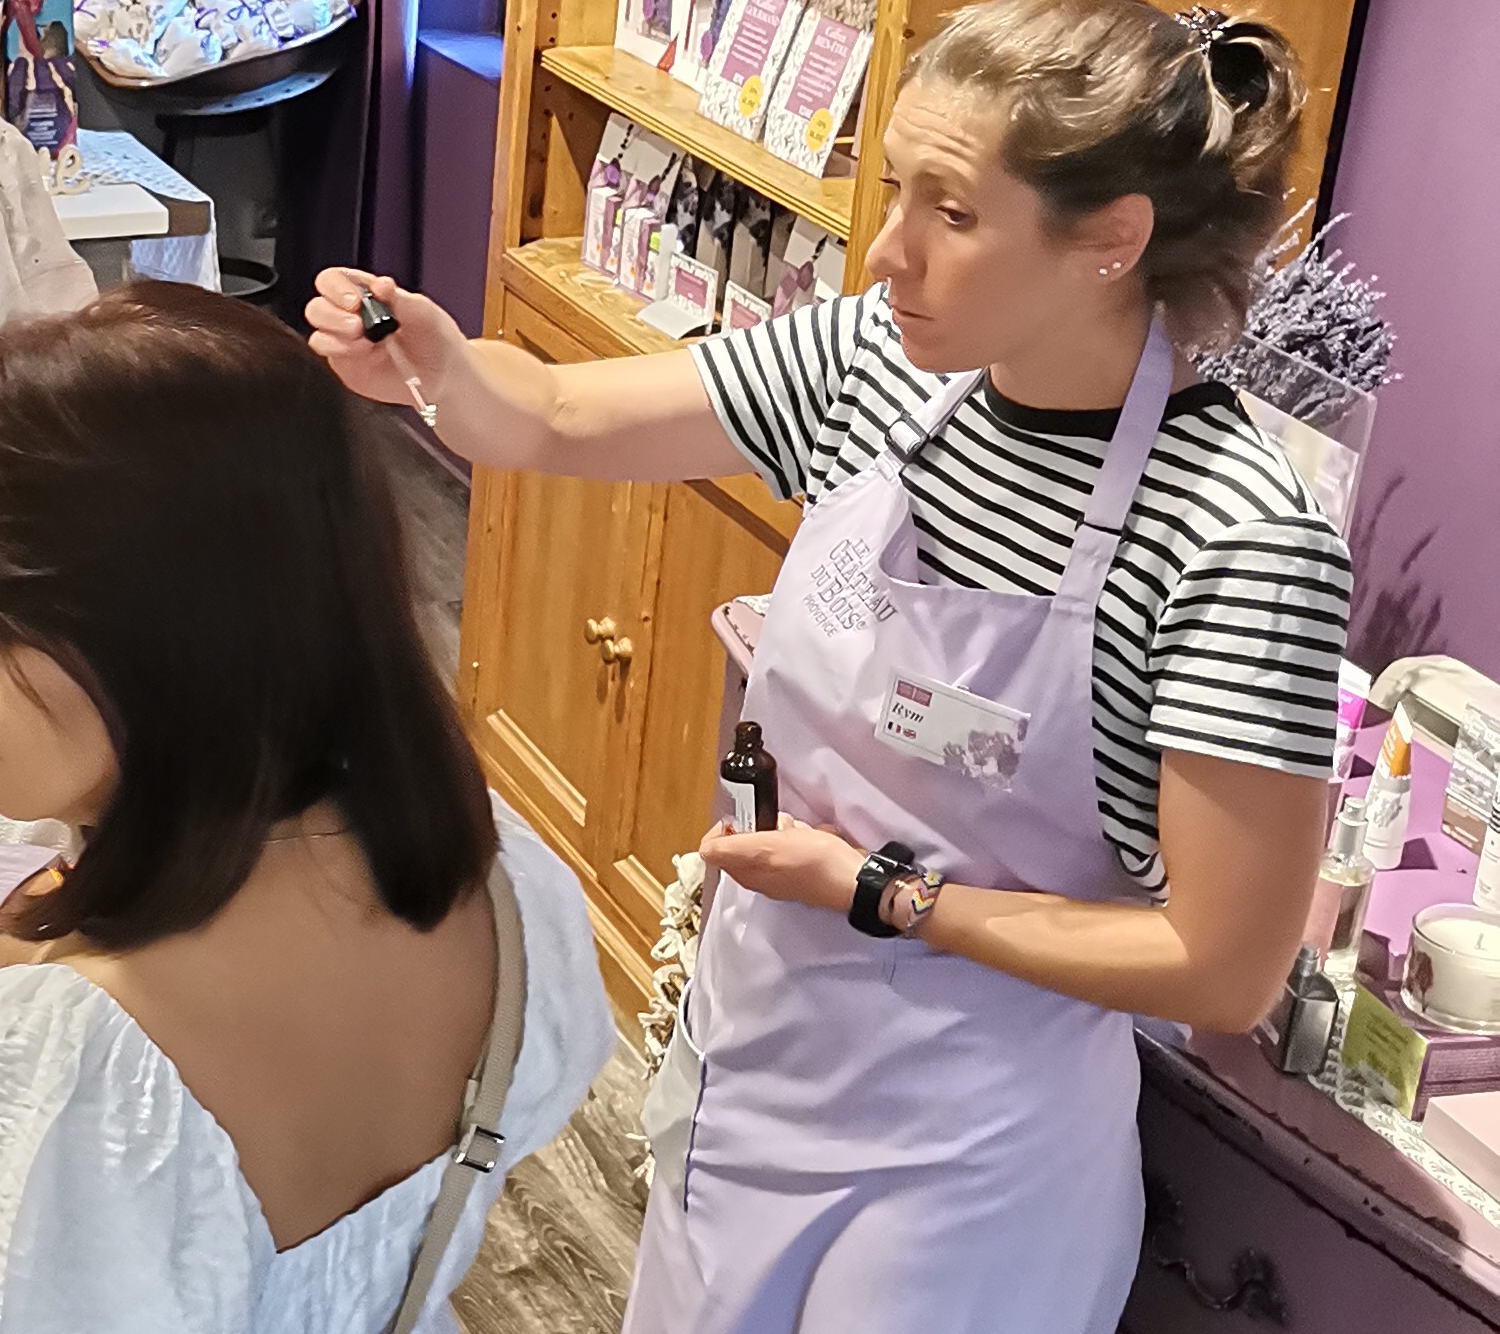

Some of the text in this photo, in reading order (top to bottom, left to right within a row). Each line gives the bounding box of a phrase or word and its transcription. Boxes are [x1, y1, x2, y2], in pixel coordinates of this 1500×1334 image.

[852, 538, 870, 559] LE
[810, 564, 831, 587] DU
[803, 593, 838, 637] PROVENCE
[892, 702, 924, 723] Rym
